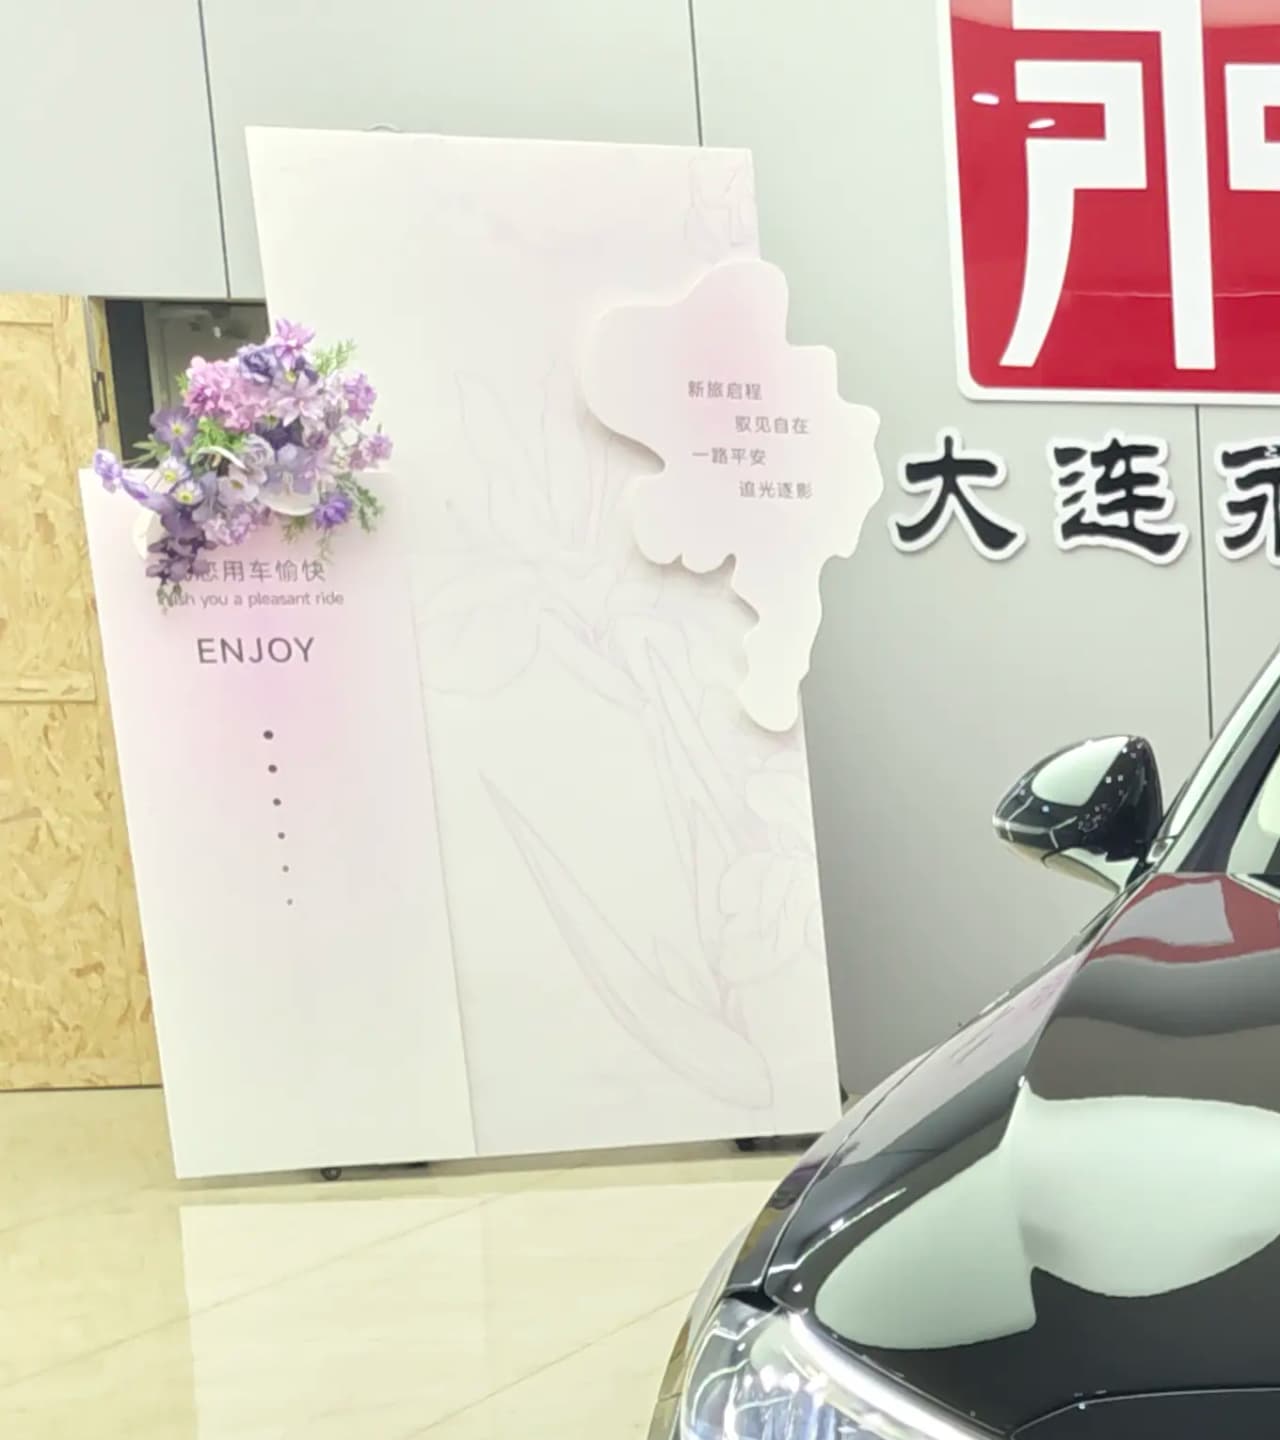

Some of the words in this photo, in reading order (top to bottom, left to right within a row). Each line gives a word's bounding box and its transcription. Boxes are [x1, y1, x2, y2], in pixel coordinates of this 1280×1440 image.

[688, 380, 762, 400] 新旅启程
[692, 447, 766, 466] 一路平安
[185, 559, 326, 582] 您用车愉快
[202, 594, 229, 608] you
[233, 594, 243, 605] a
[248, 592, 311, 608] pleasant
[316, 592, 344, 605] ride
[197, 637, 314, 664] ENJOY
